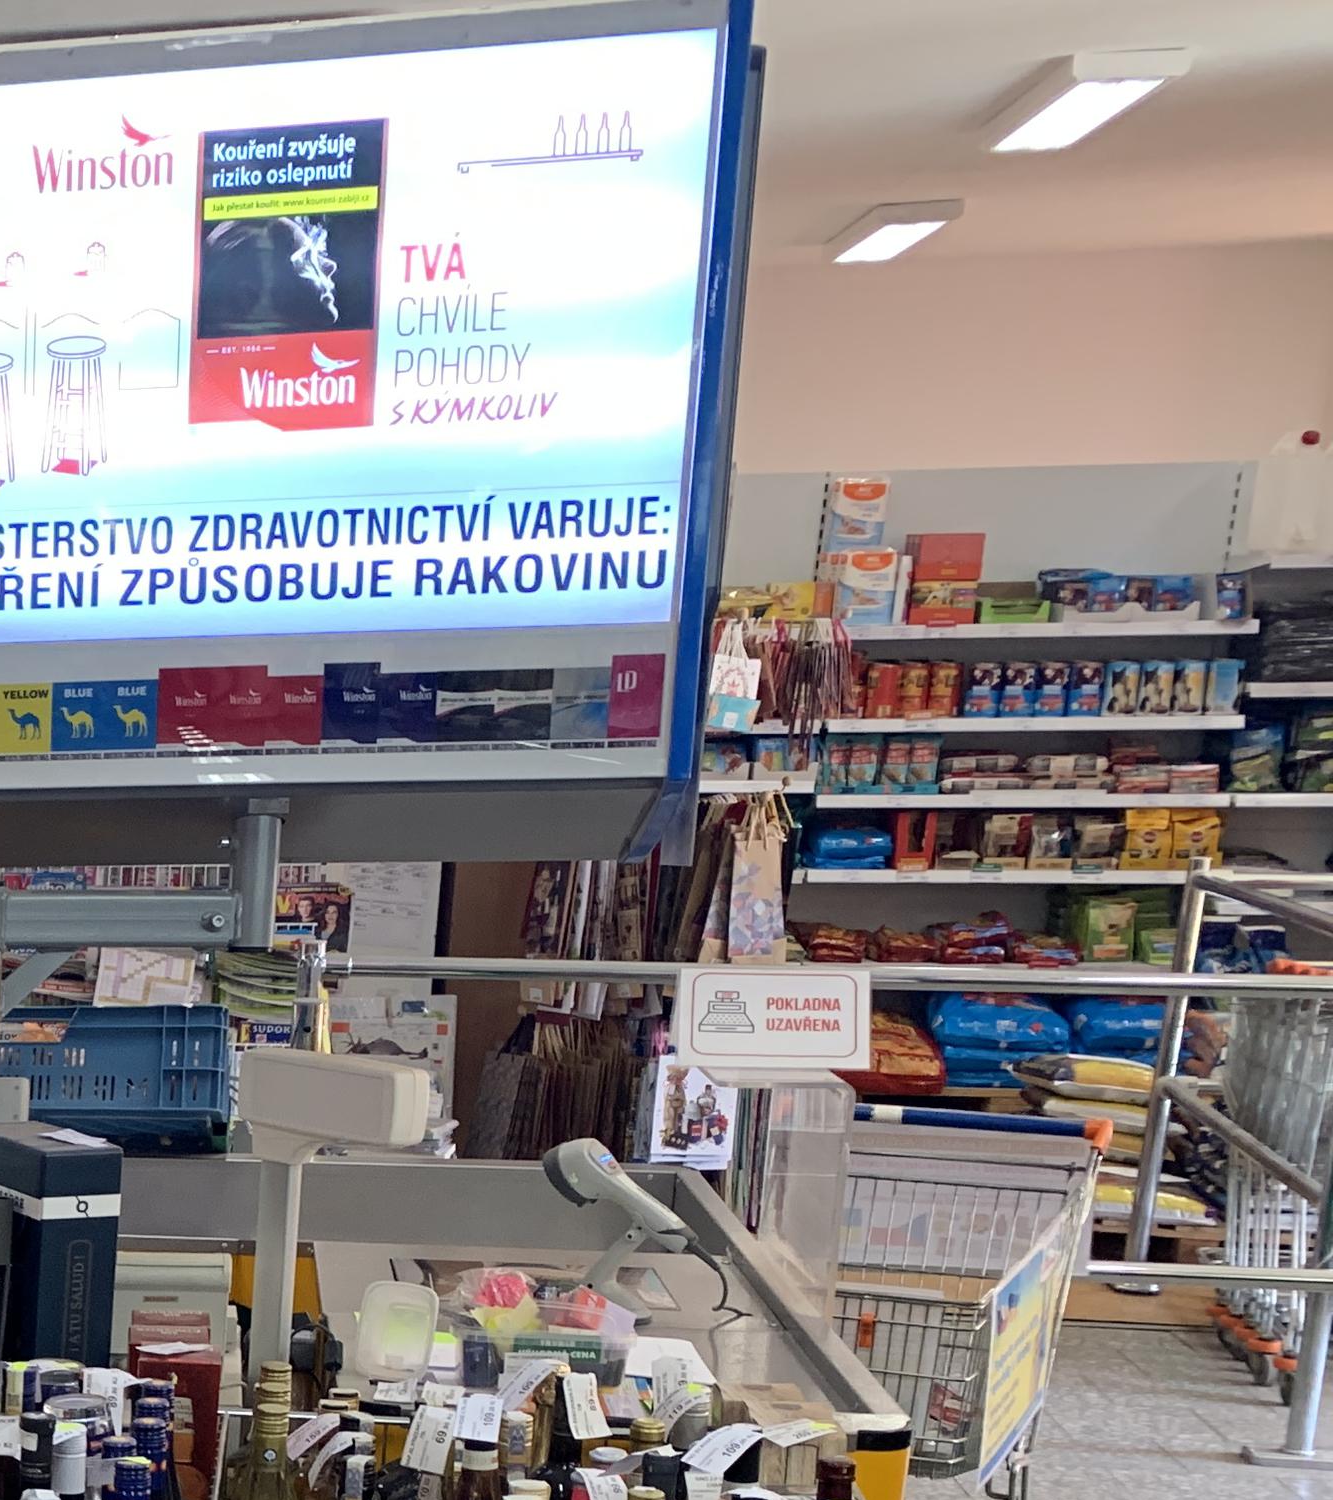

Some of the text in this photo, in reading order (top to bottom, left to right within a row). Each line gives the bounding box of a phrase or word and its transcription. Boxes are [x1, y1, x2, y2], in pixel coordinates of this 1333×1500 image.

[212, 132, 357, 162] Kouření zvyšuje
[32, 144, 174, 194] Winston
[212, 157, 354, 188] riziko oslepnutí
[399, 231, 467, 284] TVÁ
[396, 283, 509, 337] CHVÍLE
[393, 342, 532, 388] POHODY
[240, 366, 356, 409] Winston
[188, 496, 493, 554] ZDRAVOTNICTVÍ
[508, 498, 673, 541] VARUJE:
[119, 556, 394, 608] ZPŮSOBUJE
[413, 549, 668, 598] RAKOVINU
[2, 688, 49, 701] YELLOW
[63, 687, 94, 699] BLUE
[116, 685, 147, 698] BLUE
[765, 997, 842, 1012] POKLADNA
[250, 1022, 291, 1036] SUDOK
[765, 1015, 842, 1033] UZAVŘENA
